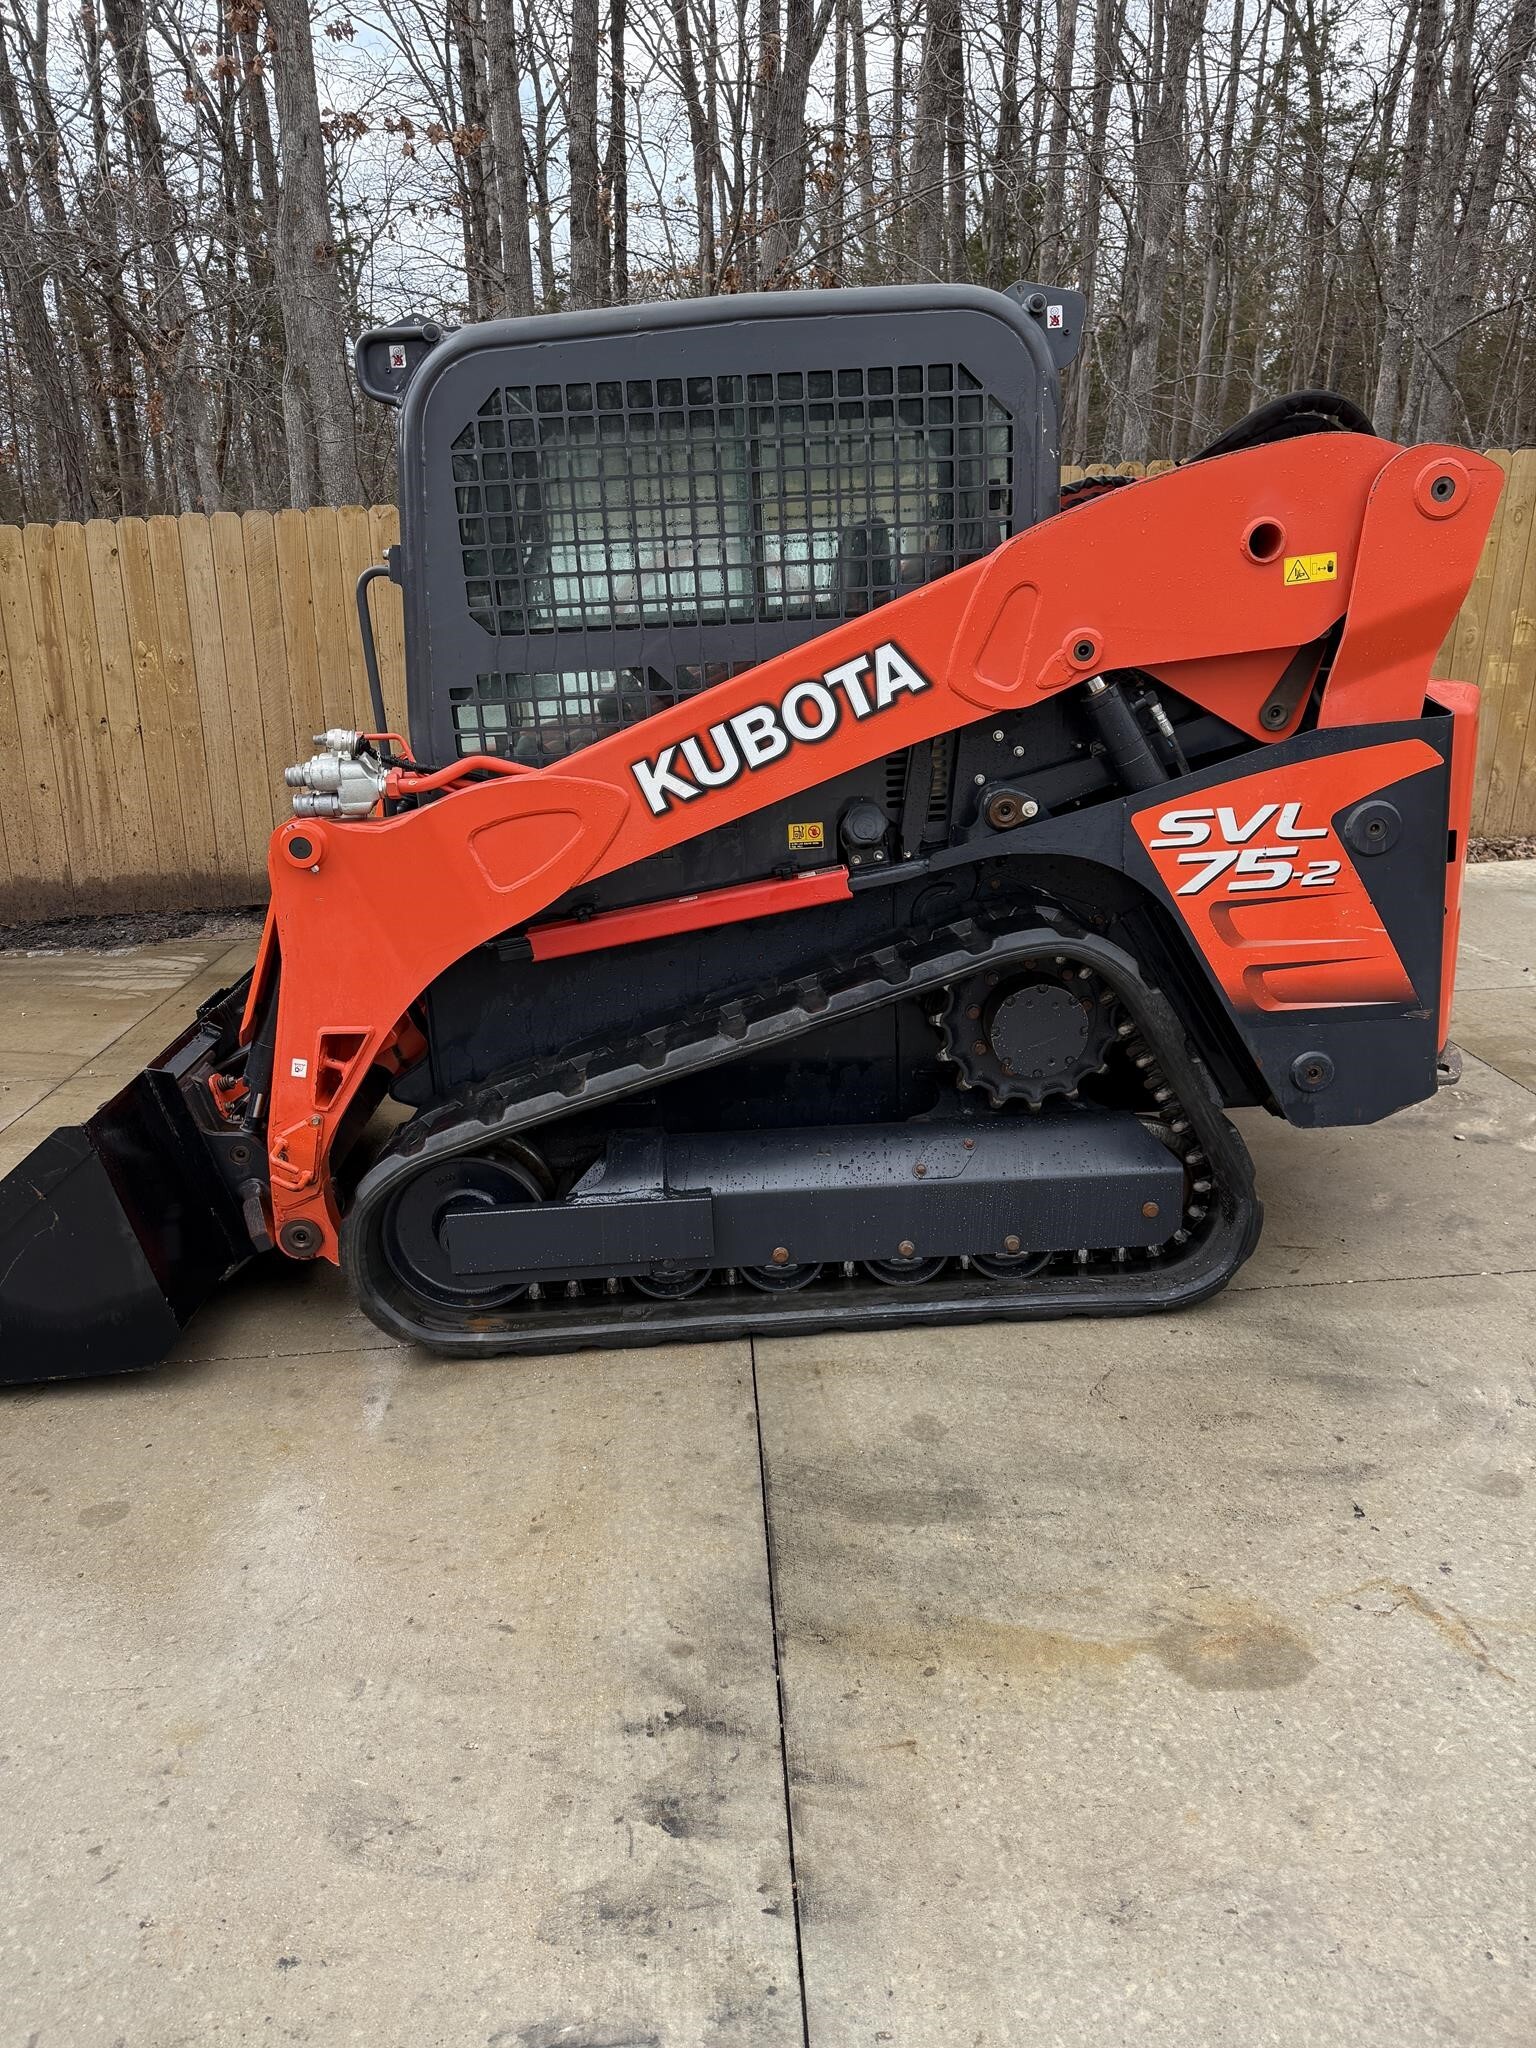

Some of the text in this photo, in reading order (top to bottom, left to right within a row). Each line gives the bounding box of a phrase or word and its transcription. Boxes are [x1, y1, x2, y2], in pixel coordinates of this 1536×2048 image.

[631, 642, 928, 815] KUBOTA
[1150, 802, 1329, 850] SVL
[1176, 846, 1342, 896] 75-2
